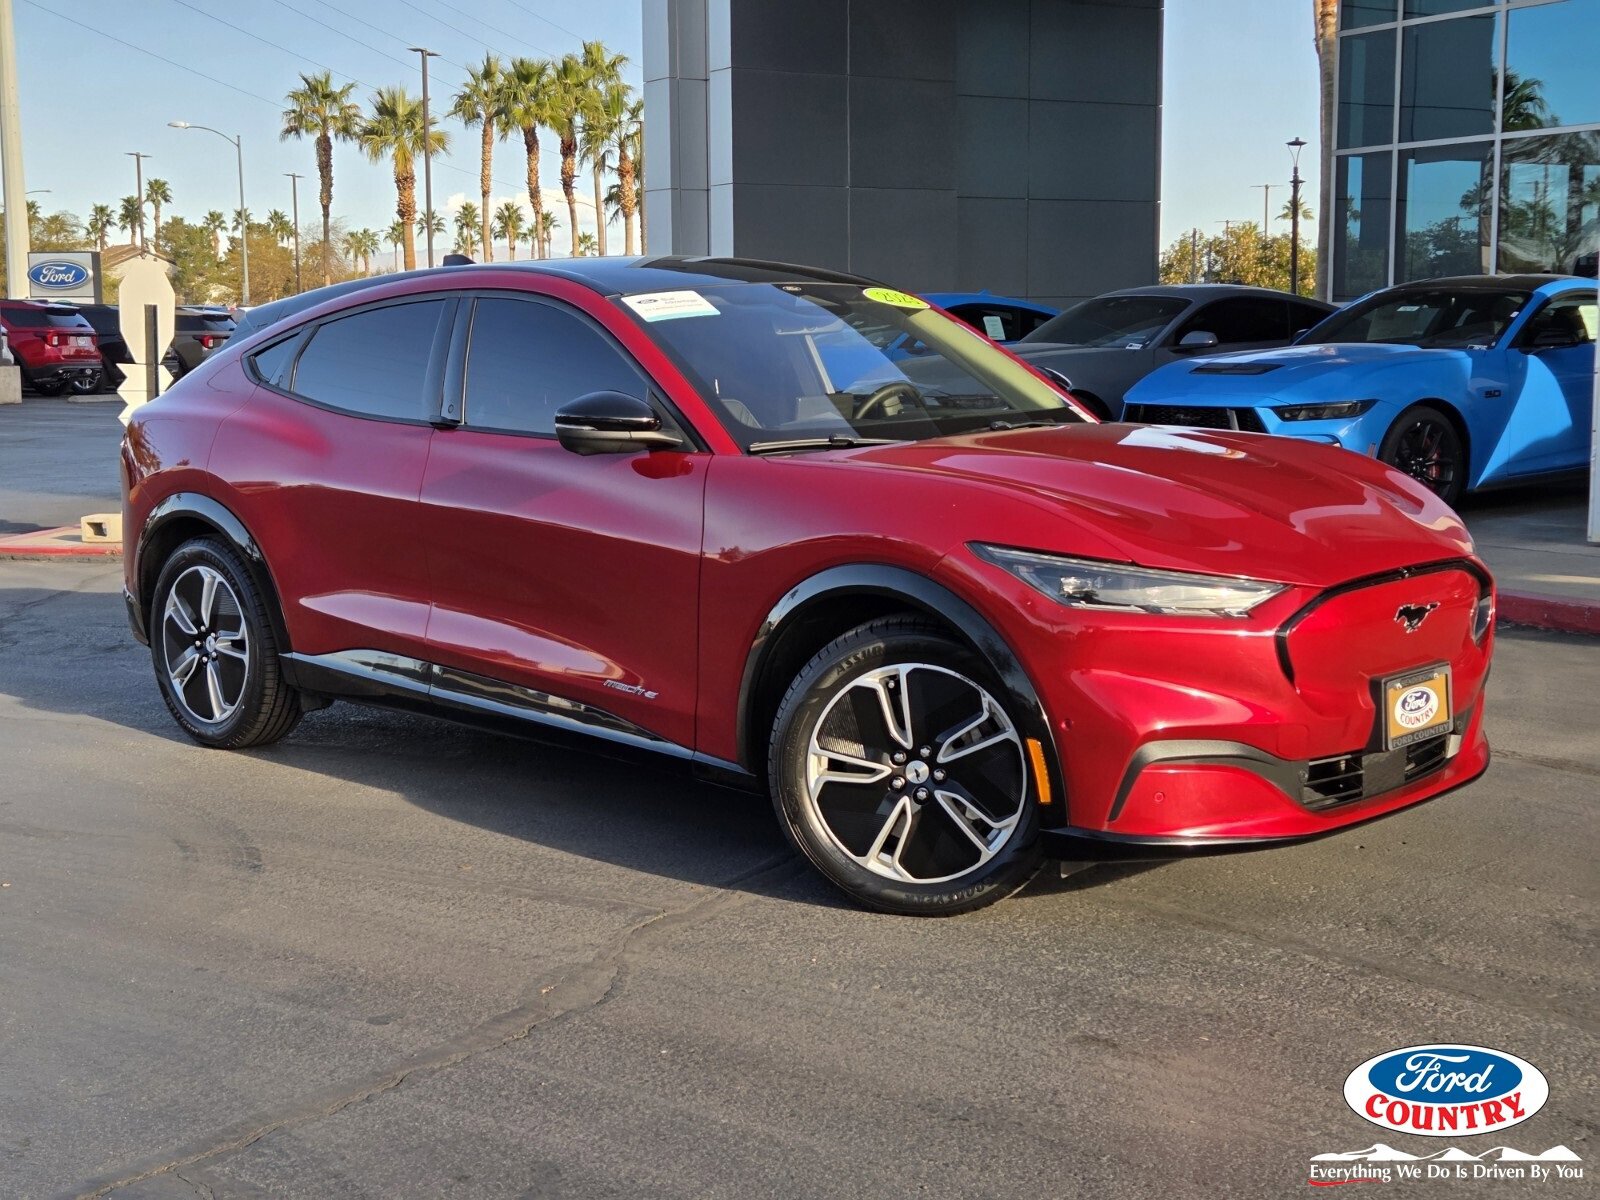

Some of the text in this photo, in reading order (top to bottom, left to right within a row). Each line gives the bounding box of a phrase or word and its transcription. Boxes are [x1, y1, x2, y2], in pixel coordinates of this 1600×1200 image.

[40, 265, 75, 282] Ford
[1405, 692, 1427, 710] Ford
[1400, 706, 1435, 725] COUNTRY
[1393, 723, 1450, 748] FORD COUNTRY
